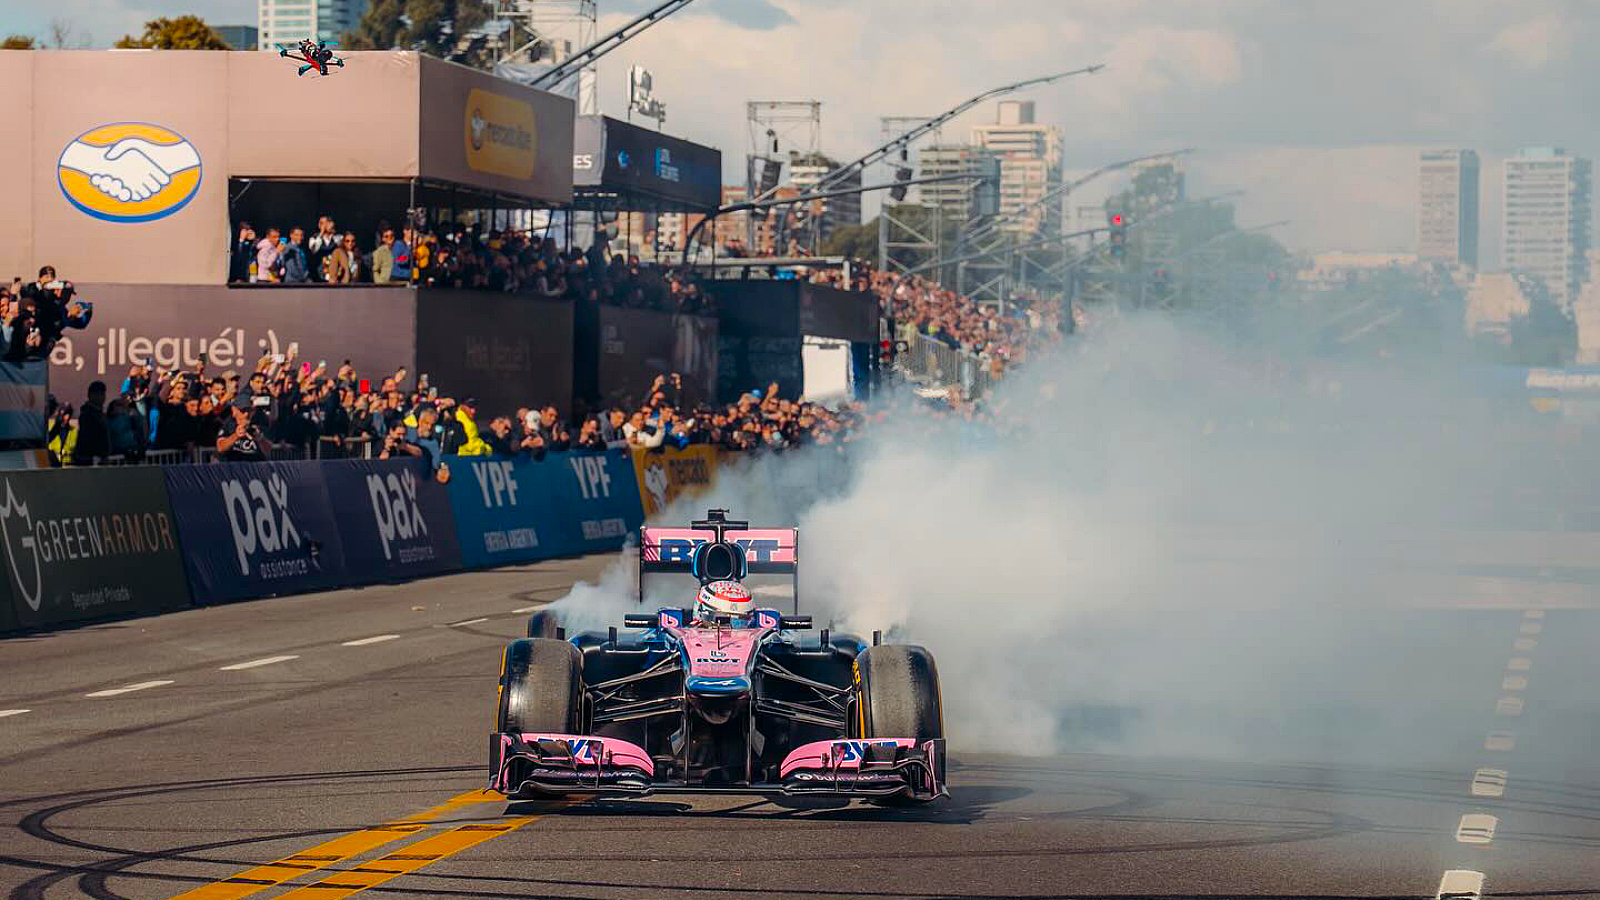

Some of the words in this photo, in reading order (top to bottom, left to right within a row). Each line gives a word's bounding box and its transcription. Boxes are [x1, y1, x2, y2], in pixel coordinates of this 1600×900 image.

[471, 460, 518, 508] YPF
[570, 455, 612, 499] YPF
[36, 512, 174, 563] GREENARMOR
[221, 472, 301, 576] pax
[365, 467, 428, 561] pax
[259, 558, 309, 579] assistance
